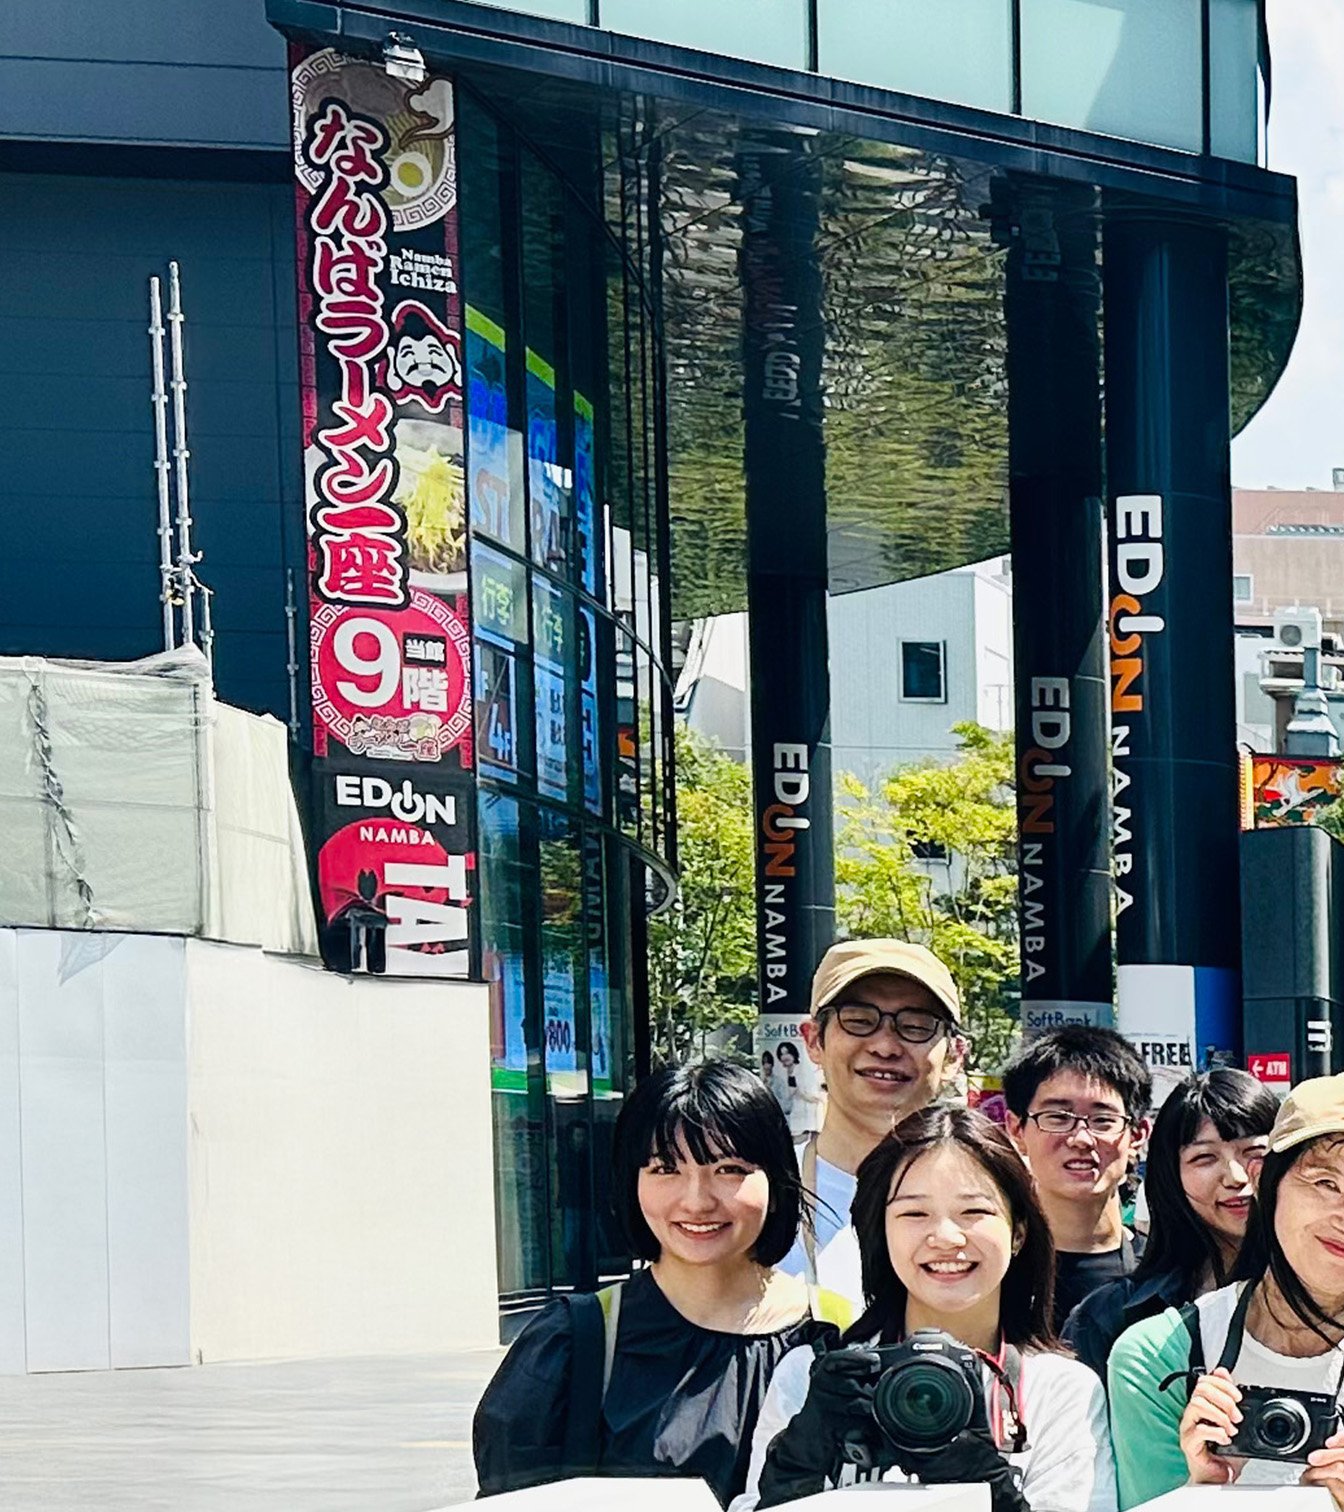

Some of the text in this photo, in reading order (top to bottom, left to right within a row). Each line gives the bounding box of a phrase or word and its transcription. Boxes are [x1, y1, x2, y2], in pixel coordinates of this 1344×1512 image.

[389, 254, 453, 278] Ramen
[401, 248, 453, 267] Namba
[390, 268, 458, 294] Ichiza
[309, 103, 404, 603] なんばラーメン一座
[1110, 494, 1166, 918] EDION NAMBA
[336, 775, 456, 825] EDION
[359, 826, 436, 847] NAMBA
[1020, 676, 1072, 983] EDION NAMBA
[762, 741, 811, 1005] EDION NAMBA
[1140, 1042, 1193, 1067] FREE
[1265, 1060, 1288, 1076] ATM
